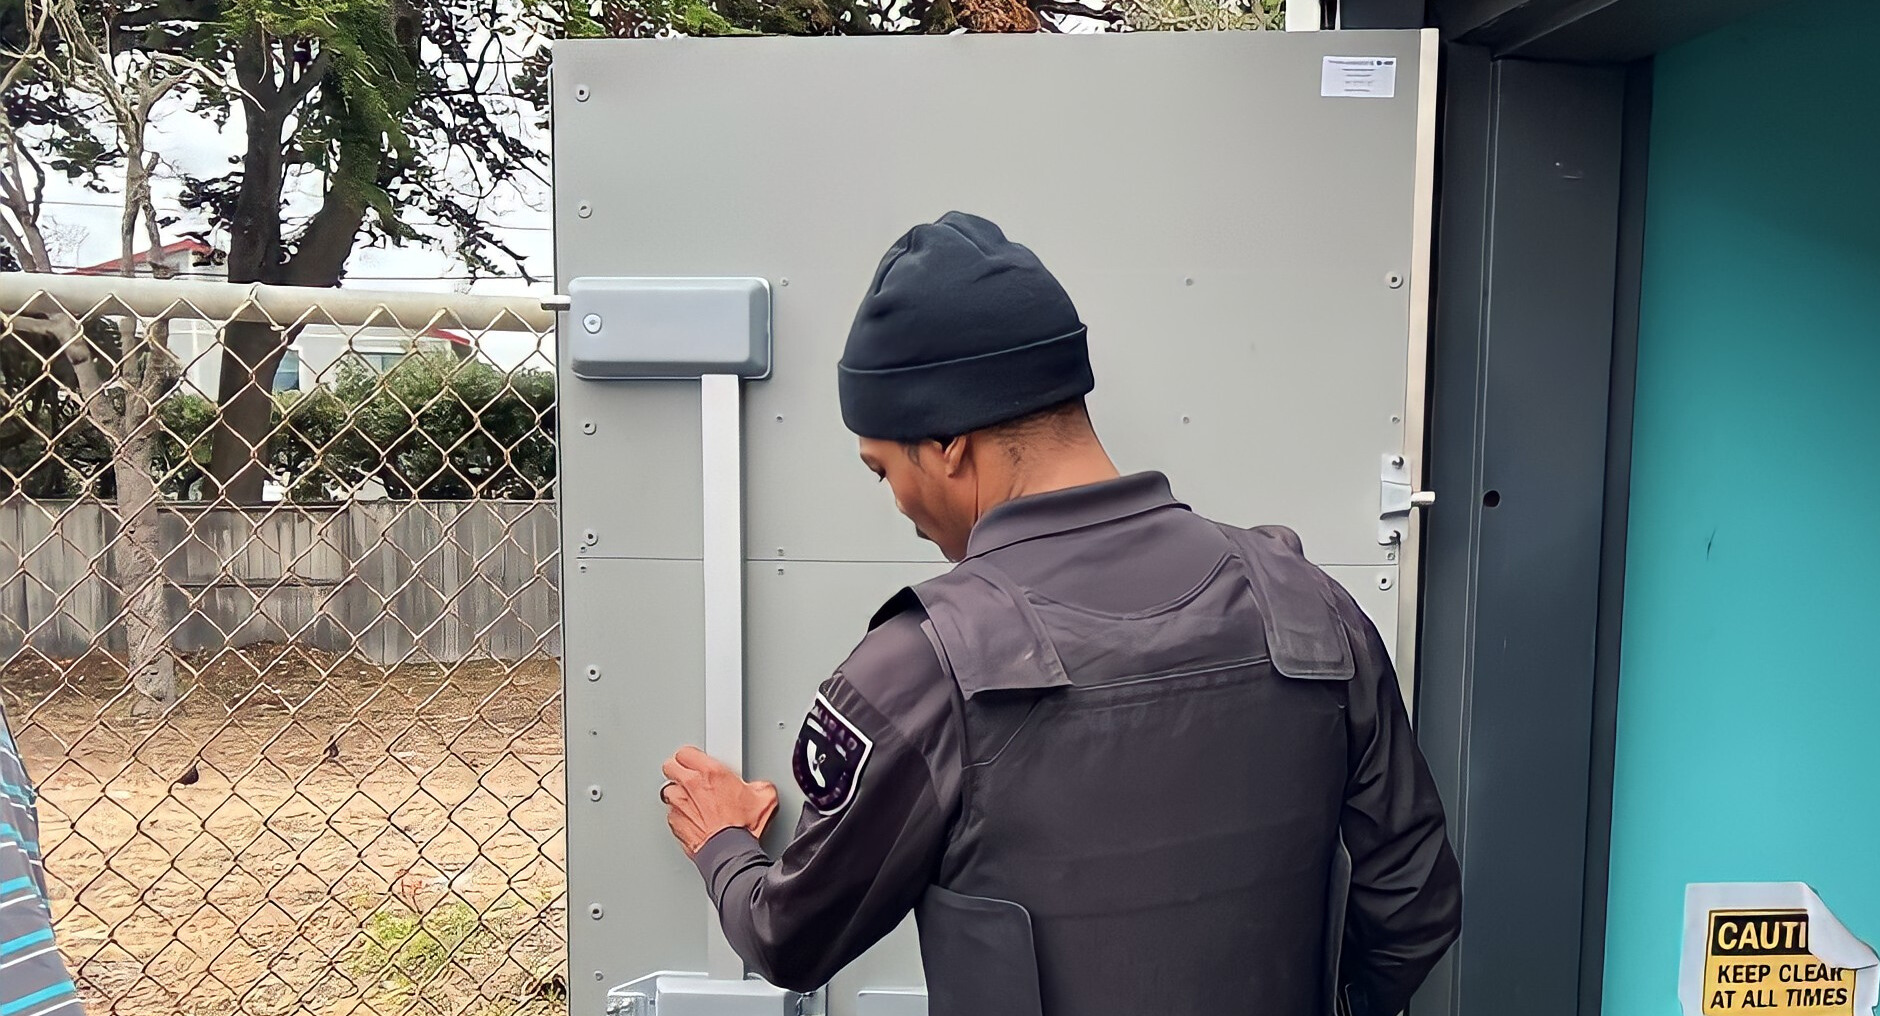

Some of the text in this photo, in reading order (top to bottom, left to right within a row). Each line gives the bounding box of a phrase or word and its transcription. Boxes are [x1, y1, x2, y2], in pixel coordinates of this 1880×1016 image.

[1717, 963, 1843, 984] KEEP CLEAR
[1710, 987, 1848, 1009] AT ALL TIMES
